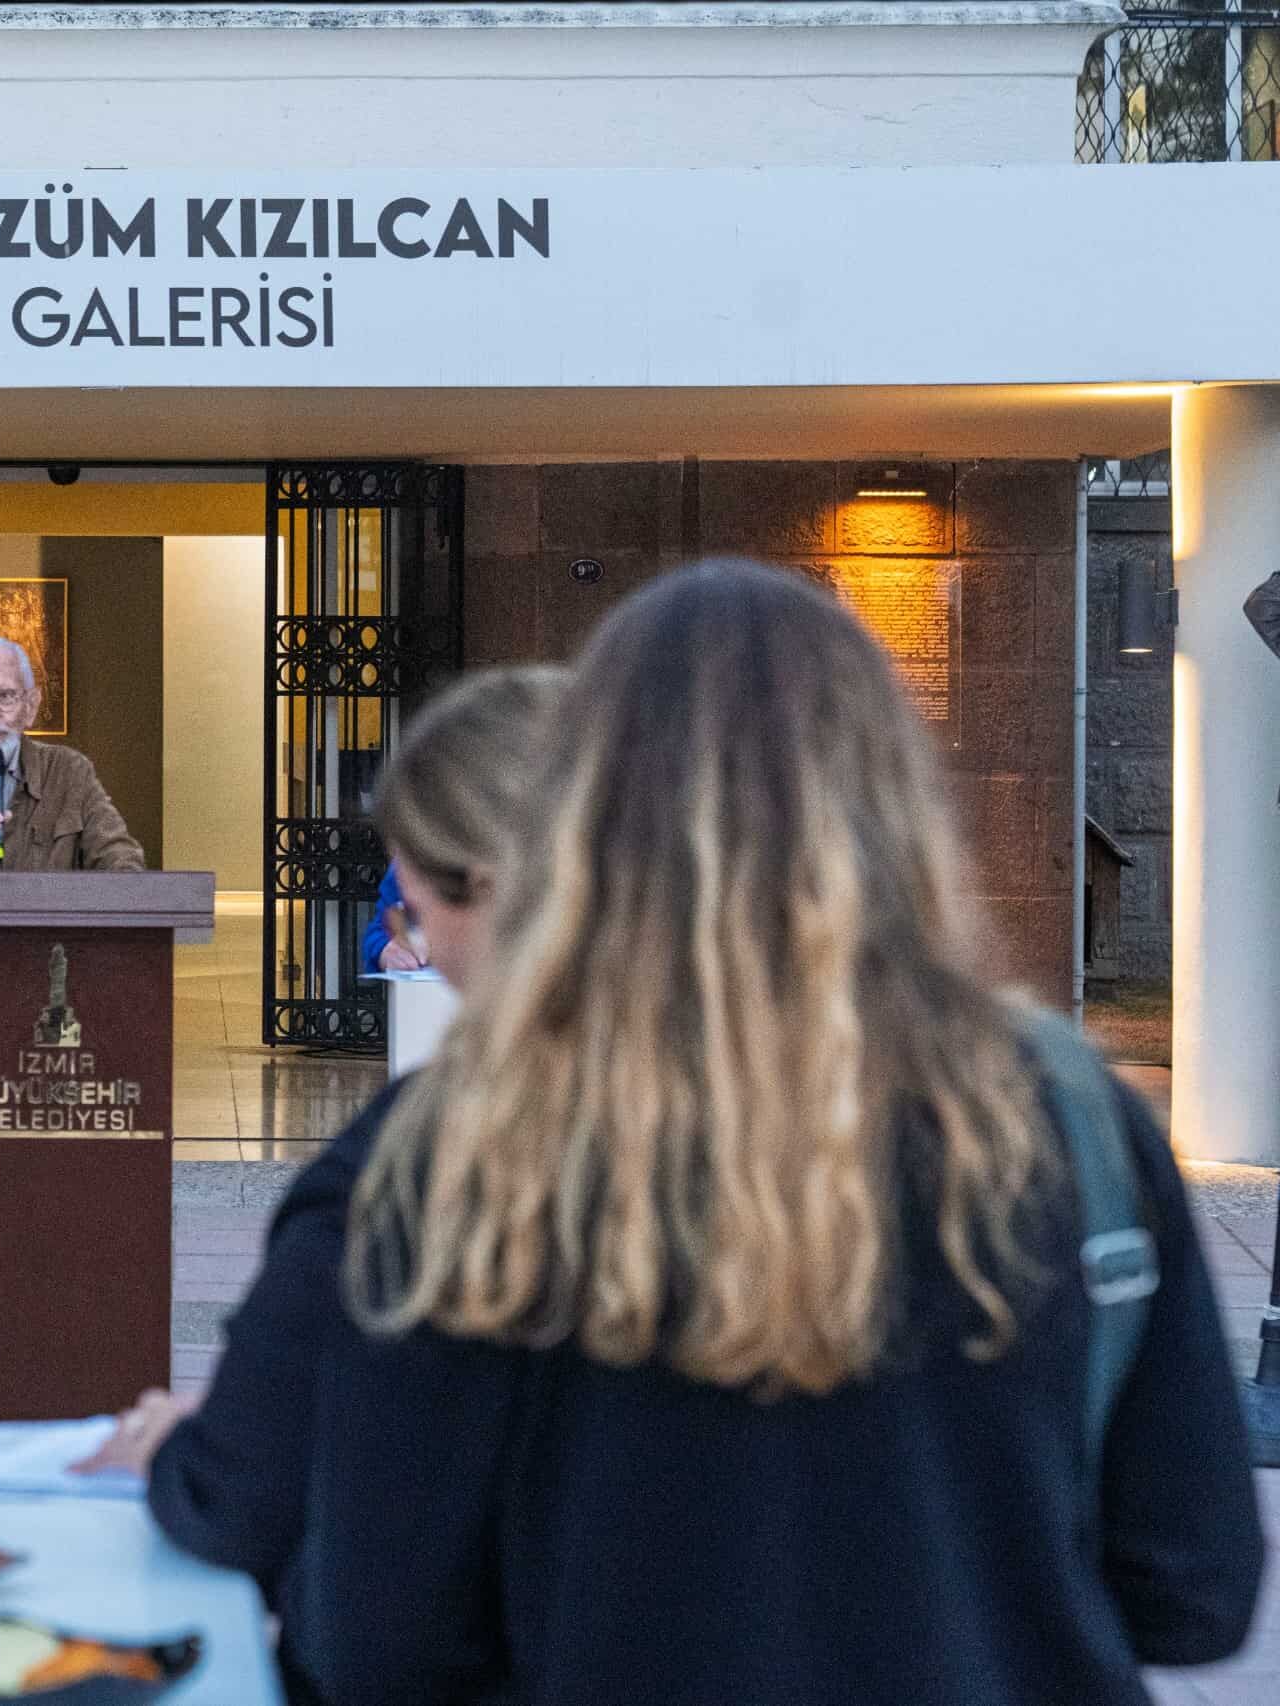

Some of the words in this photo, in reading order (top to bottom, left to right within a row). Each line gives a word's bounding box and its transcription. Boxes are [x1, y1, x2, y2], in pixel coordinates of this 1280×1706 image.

[187, 197, 550, 260] KIZILCAN
[11, 272, 334, 348] GALERİSİ
[19, 1050, 95, 1075] İZMİR
